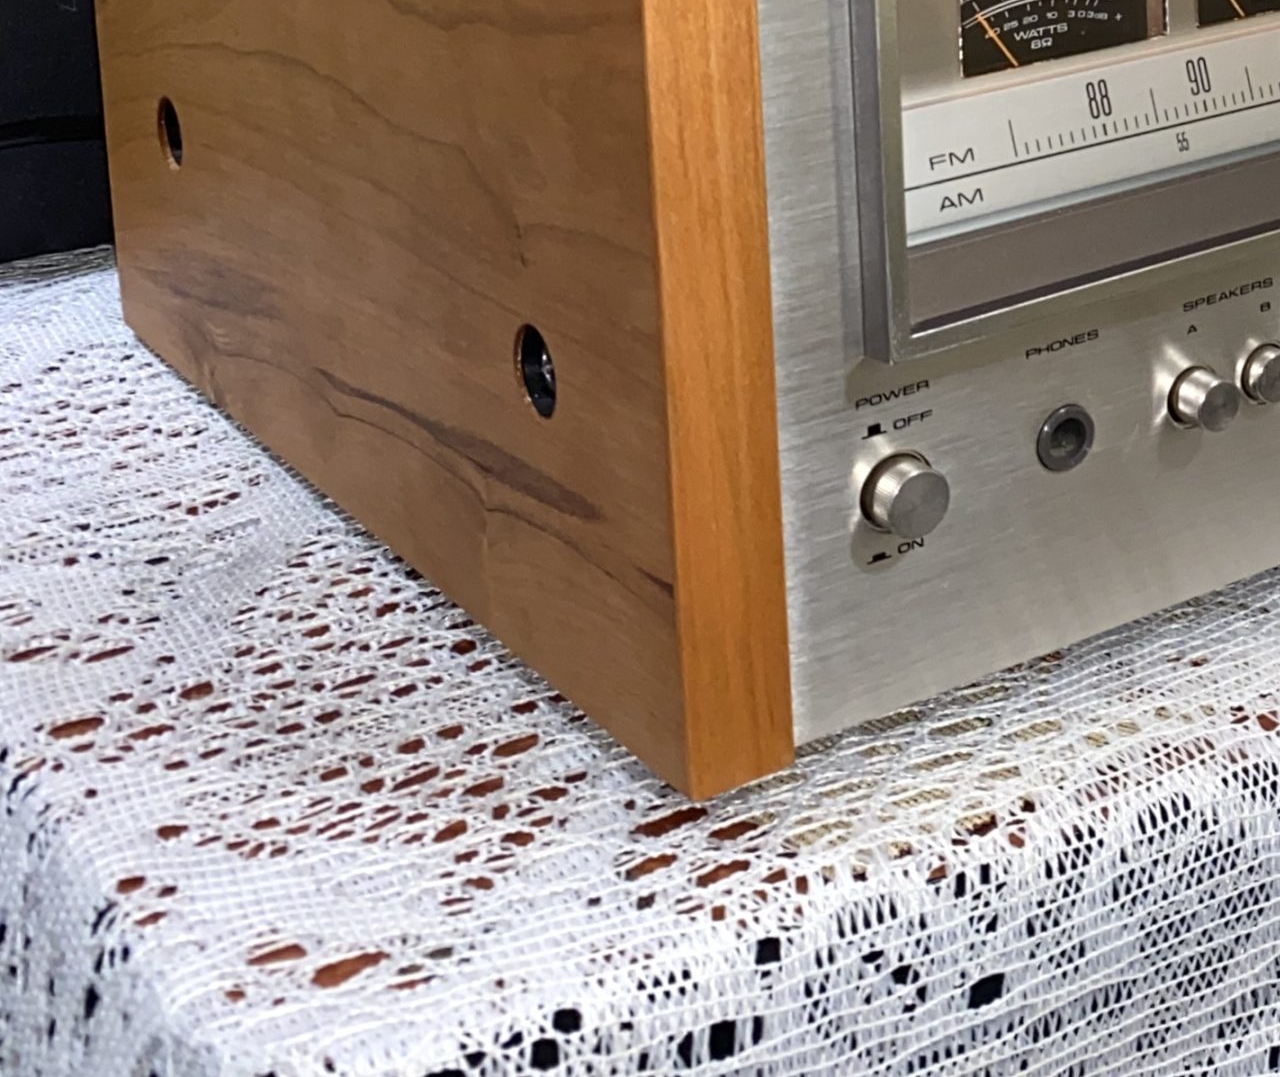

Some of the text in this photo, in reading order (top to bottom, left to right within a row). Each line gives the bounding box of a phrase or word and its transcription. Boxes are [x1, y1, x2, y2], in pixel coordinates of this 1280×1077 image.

[1014, 22, 1069, 41] WATTS
[928, 147, 975, 172] FM
[1085, 78, 1113, 121] 88
[1186, 57, 1212, 97] 90
[939, 188, 984, 212] AM
[1176, 133, 1190, 153] 55
[1182, 277, 1274, 313] SPEAKERS
[1186, 301, 1271, 336] A B
[1025, 329, 1100, 360] PHONES
[854, 379, 930, 411] POWER
[892, 409, 934, 431] OFF
[897, 536, 925, 555] ON
